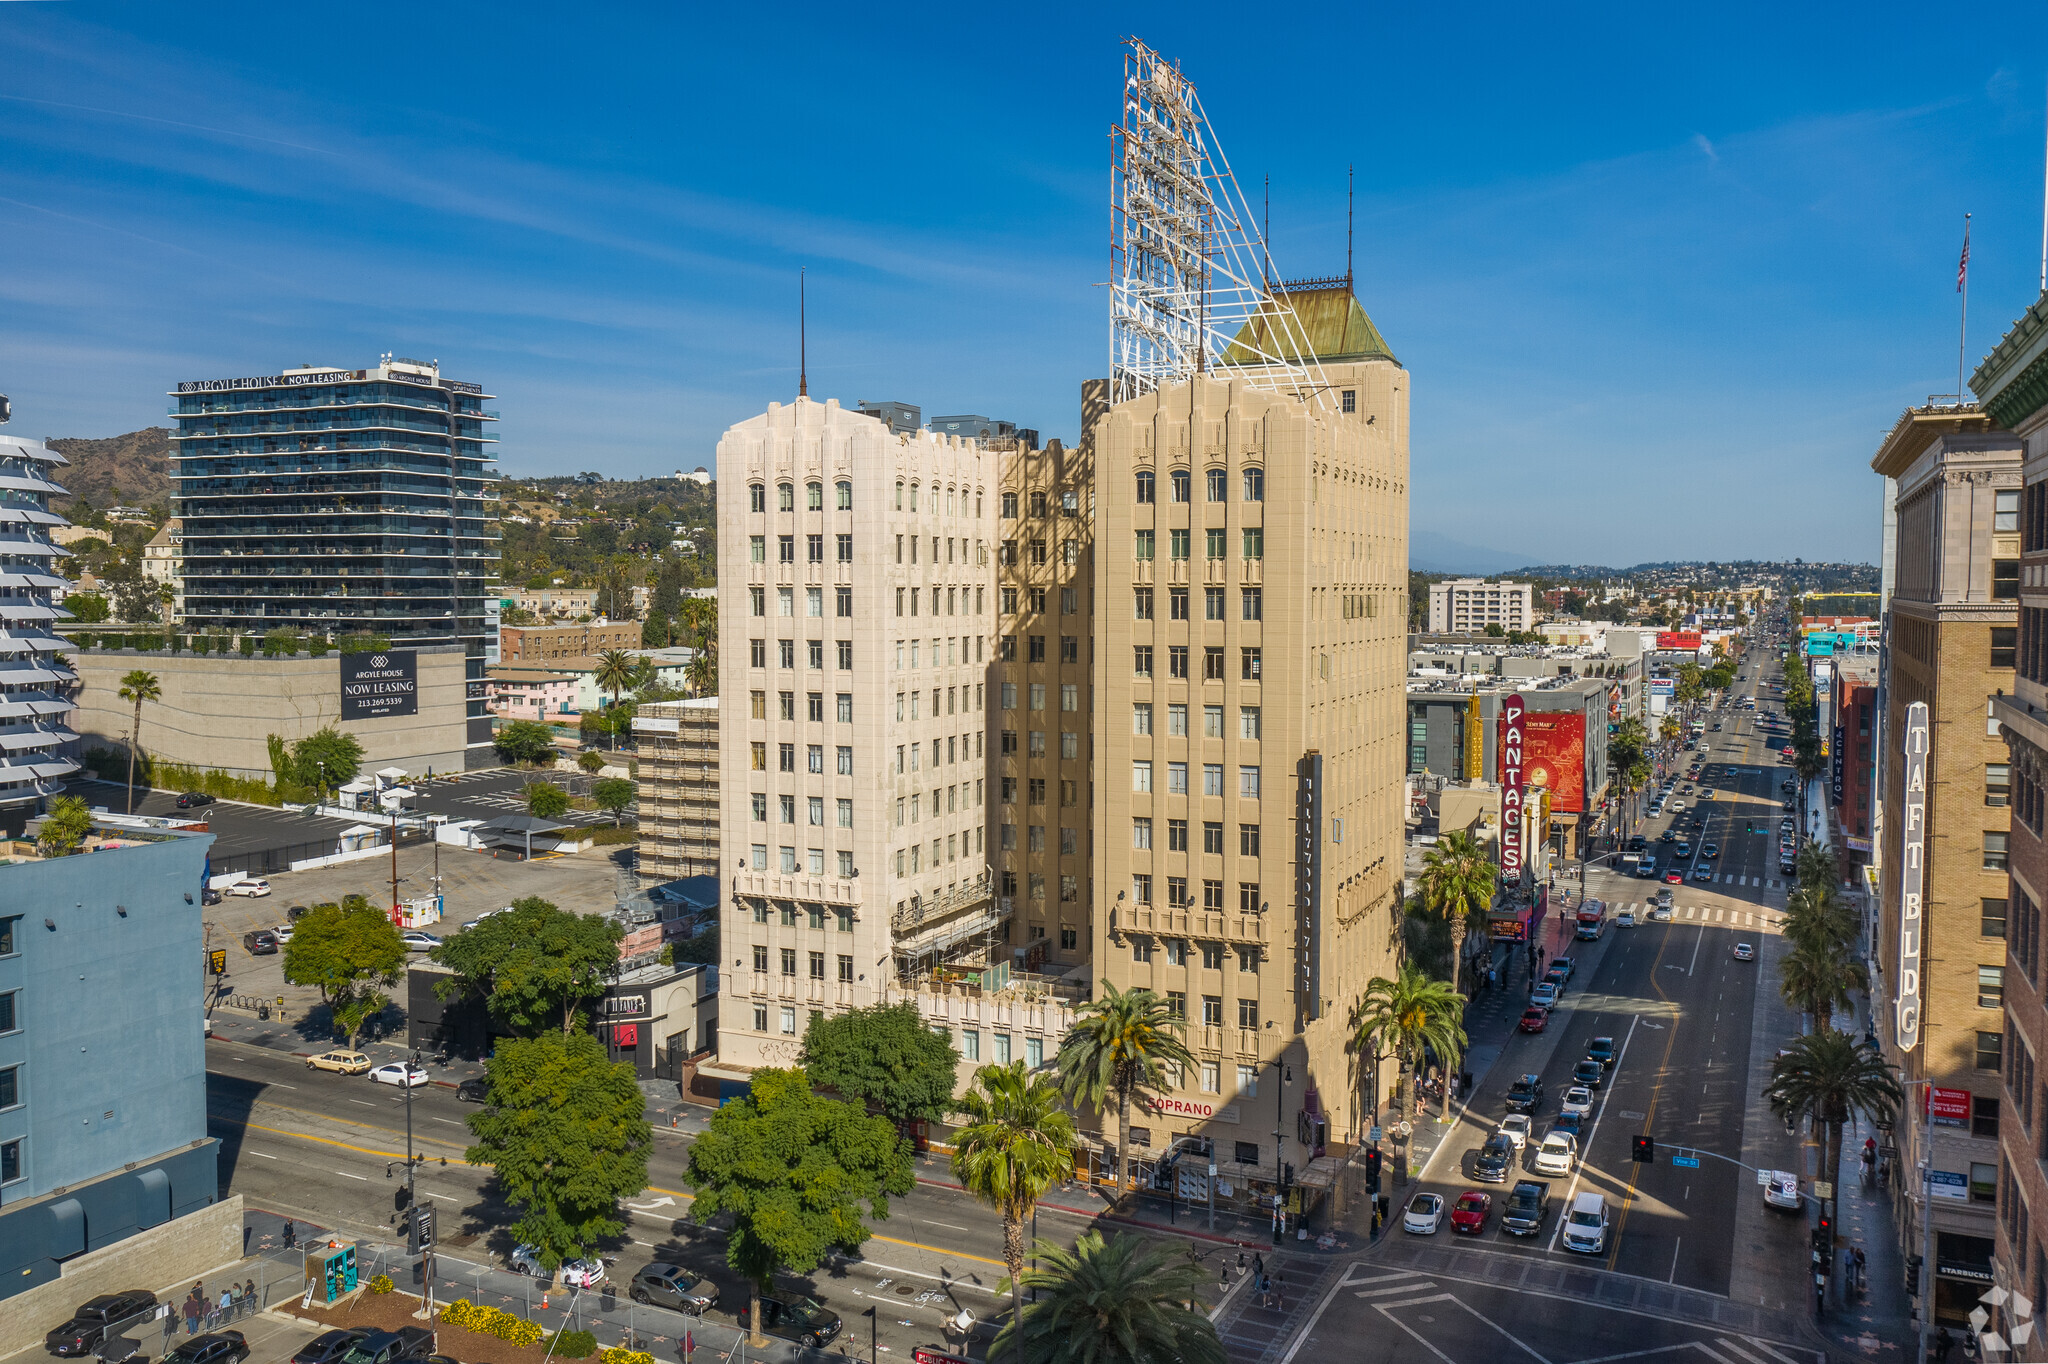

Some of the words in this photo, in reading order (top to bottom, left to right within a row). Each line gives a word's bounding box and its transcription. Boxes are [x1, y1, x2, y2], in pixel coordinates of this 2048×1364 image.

[197, 378, 238, 391] ARGYLE
[241, 375, 279, 388] HOUSE
[289, 374, 310, 385] NOW
[312, 372, 351, 383] LEASING
[355, 670, 380, 679] ARGYLE
[381, 669, 404, 677] HOUSE
[345, 683, 371, 696] NOW
[374, 681, 414, 694] LEASING
[1834, 740, 1843, 792] CENTRO
[1503, 707, 1522, 867] PANTAGES
[1907, 726, 1926, 869] TAFT
[1901, 892, 1921, 1034] BLDG
[1148, 1097, 1212, 1116] SOPRANO
[1941, 1266, 1990, 1280] STARBUCKS
